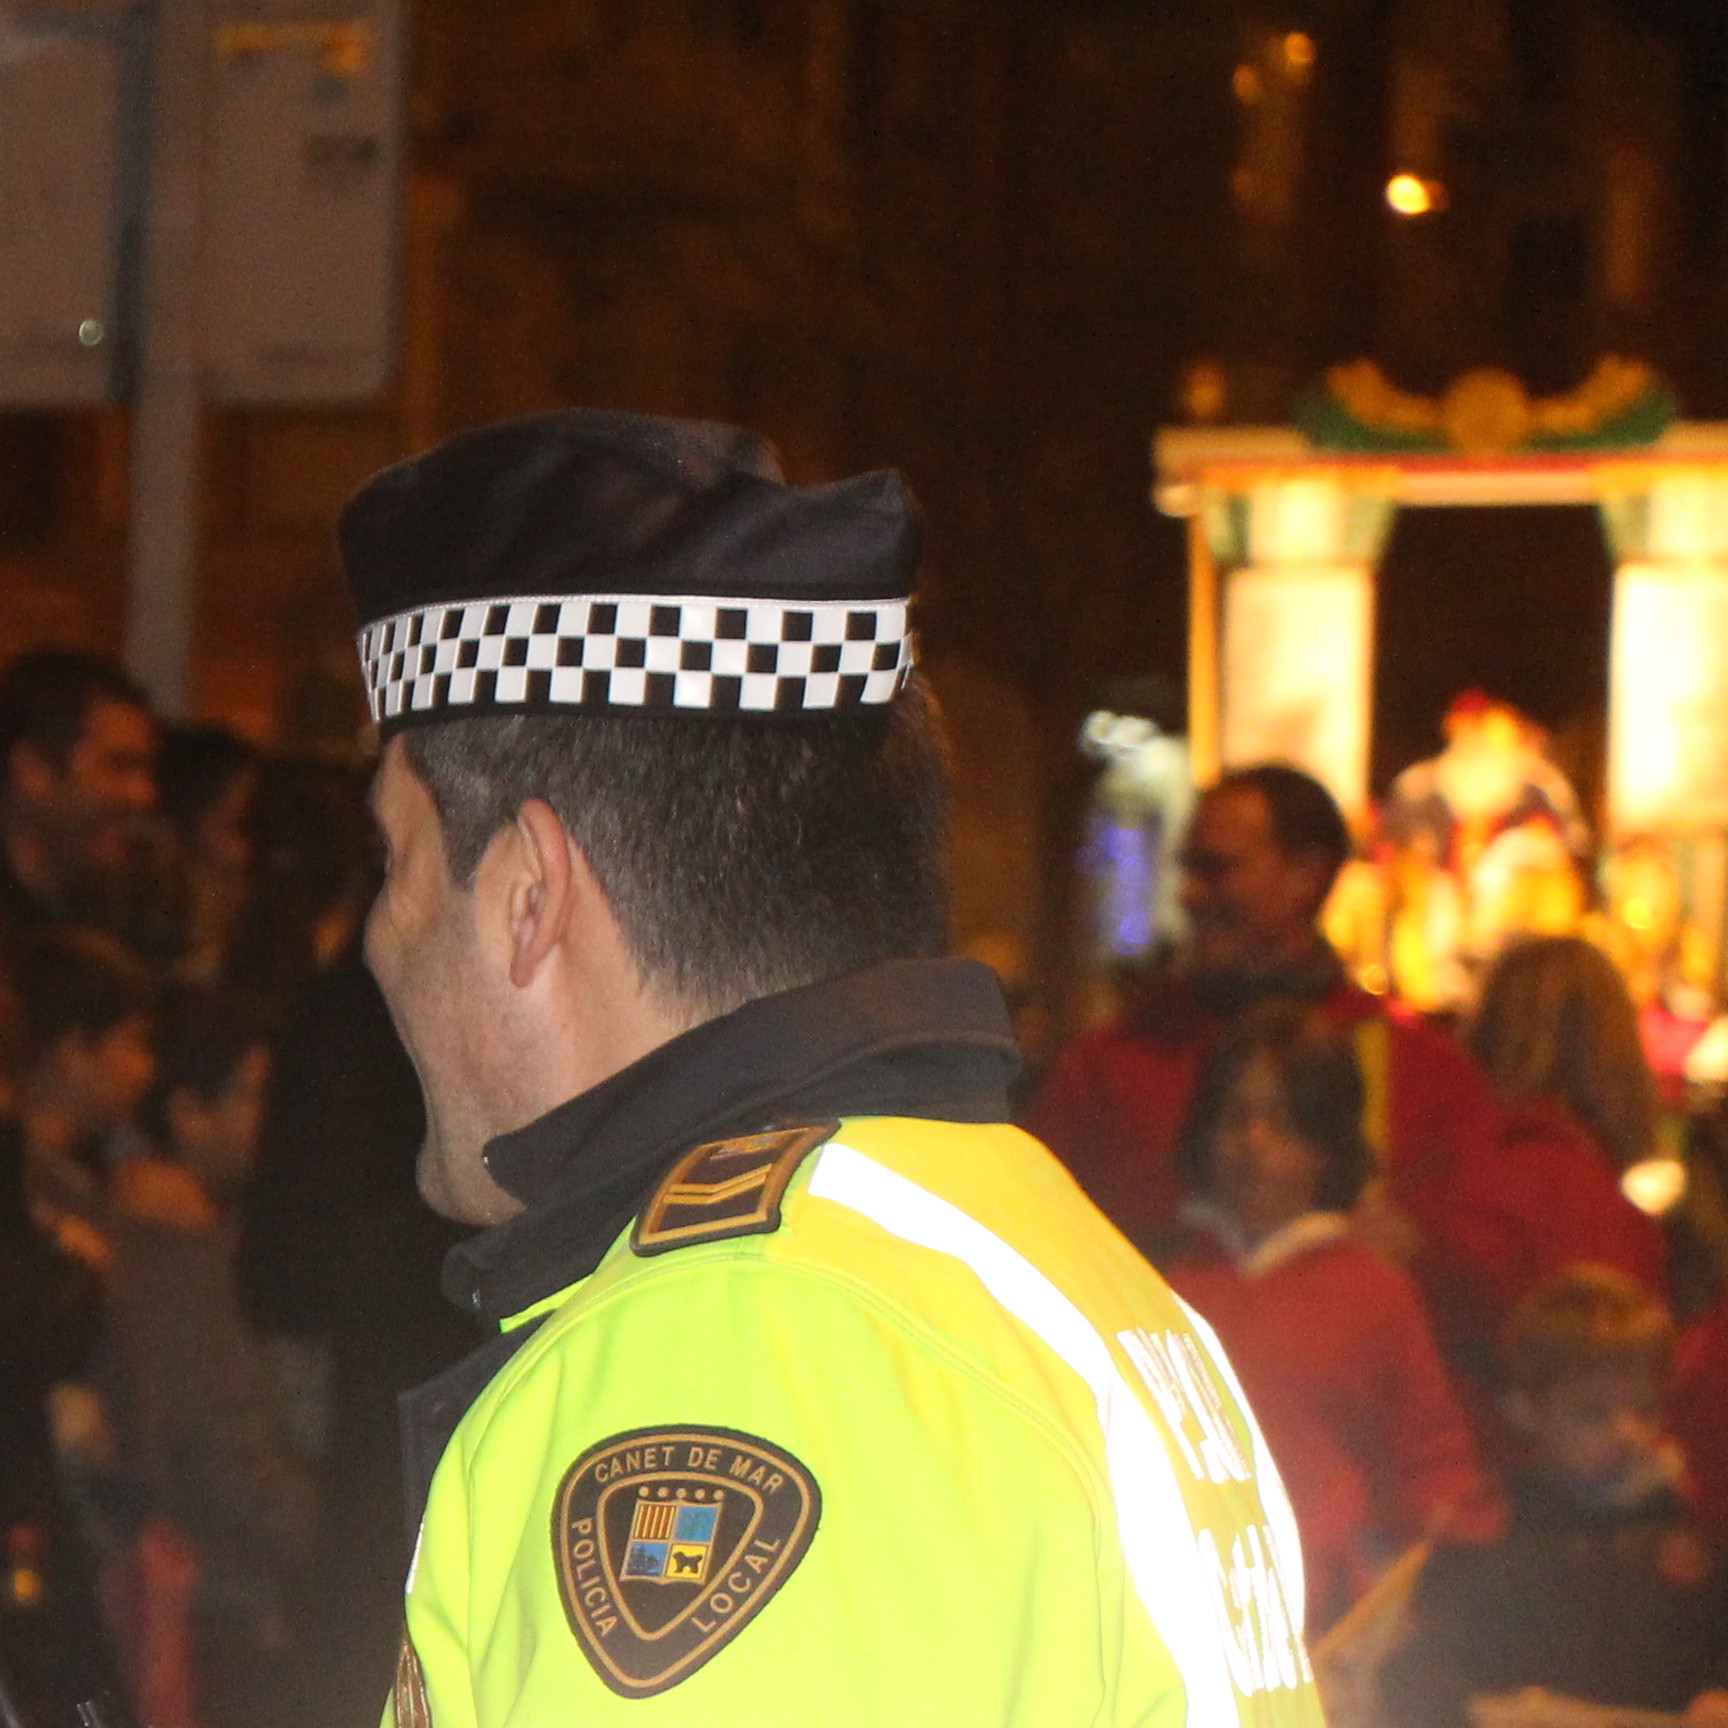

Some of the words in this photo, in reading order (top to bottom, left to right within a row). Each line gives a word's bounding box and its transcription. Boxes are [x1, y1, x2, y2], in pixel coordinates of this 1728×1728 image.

[595, 1446, 676, 1483] CANET
[687, 1446, 723, 1471] DE
[729, 1454, 785, 1495] MAR
[571, 1517, 618, 1637] POLICIA
[691, 1537, 782, 1635] LOCAL
